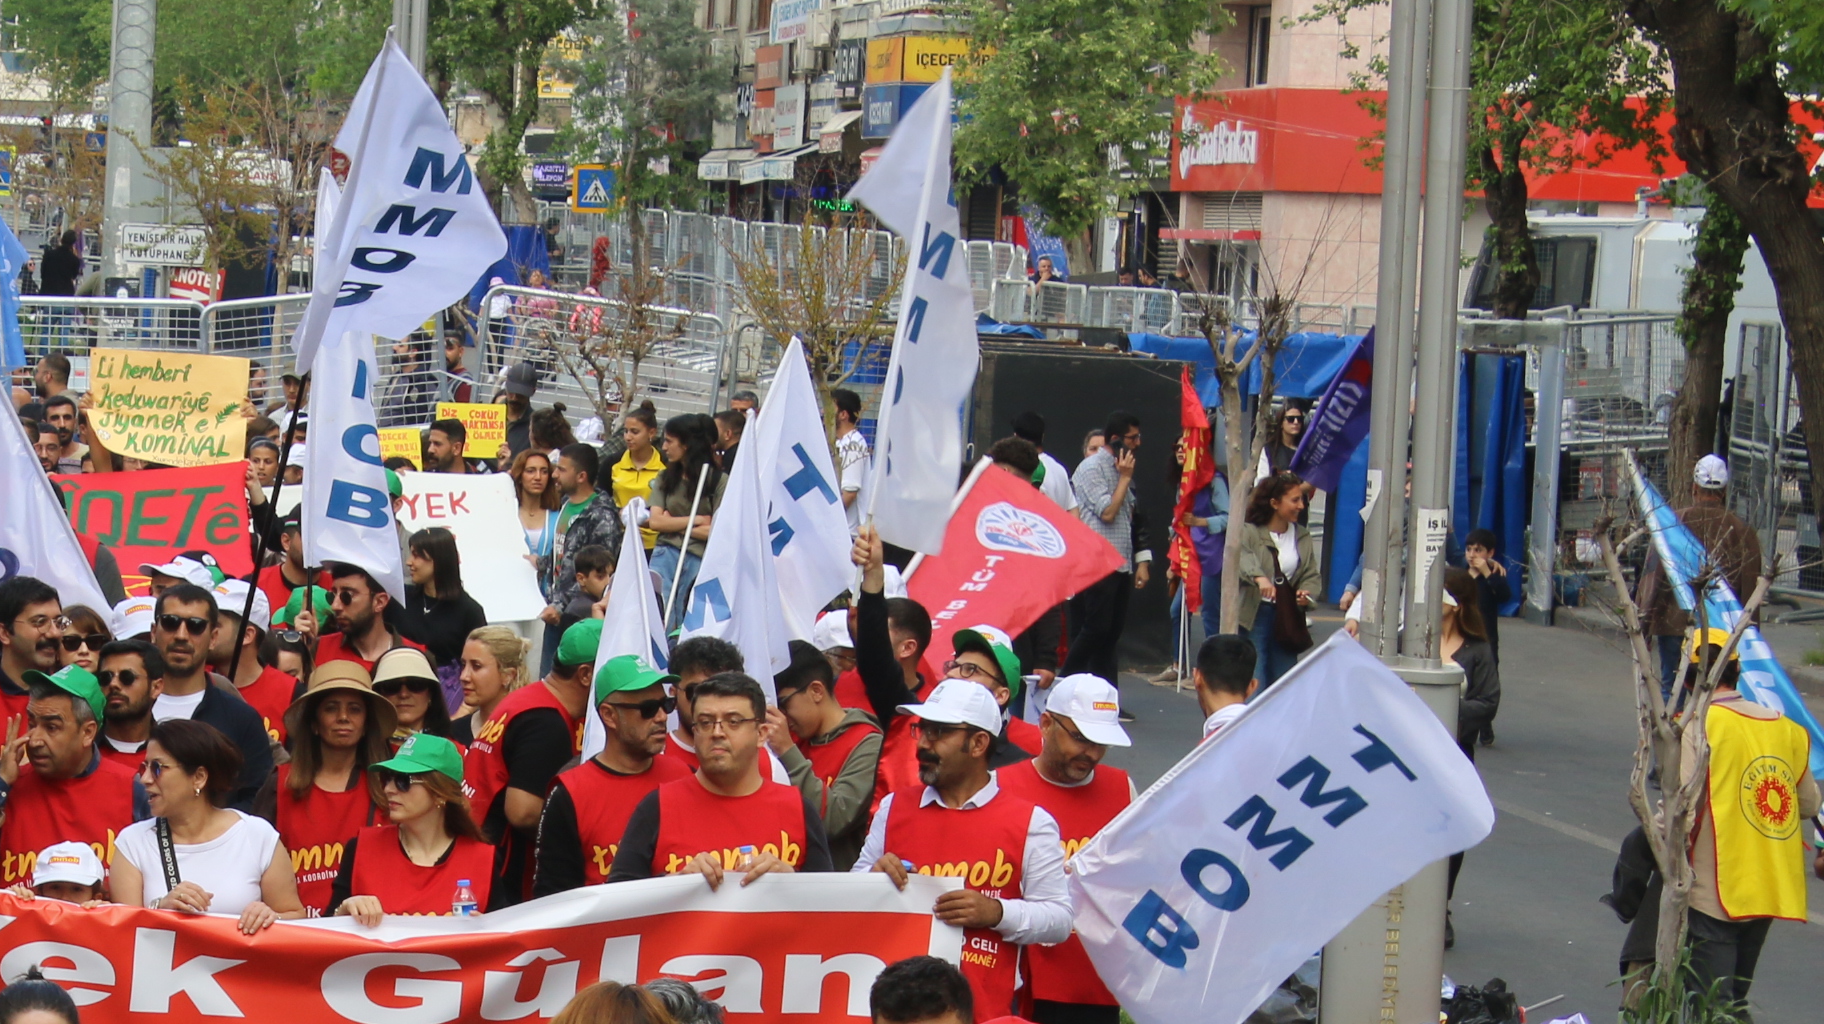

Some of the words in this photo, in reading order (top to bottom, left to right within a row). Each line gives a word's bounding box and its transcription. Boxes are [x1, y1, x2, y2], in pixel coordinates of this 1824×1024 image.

[401, 490, 470, 521] YEK
[959, 554, 1005, 592] TÜM
[1121, 723, 1418, 969] TMMOB
[971, 937, 998, 954] GEL!
